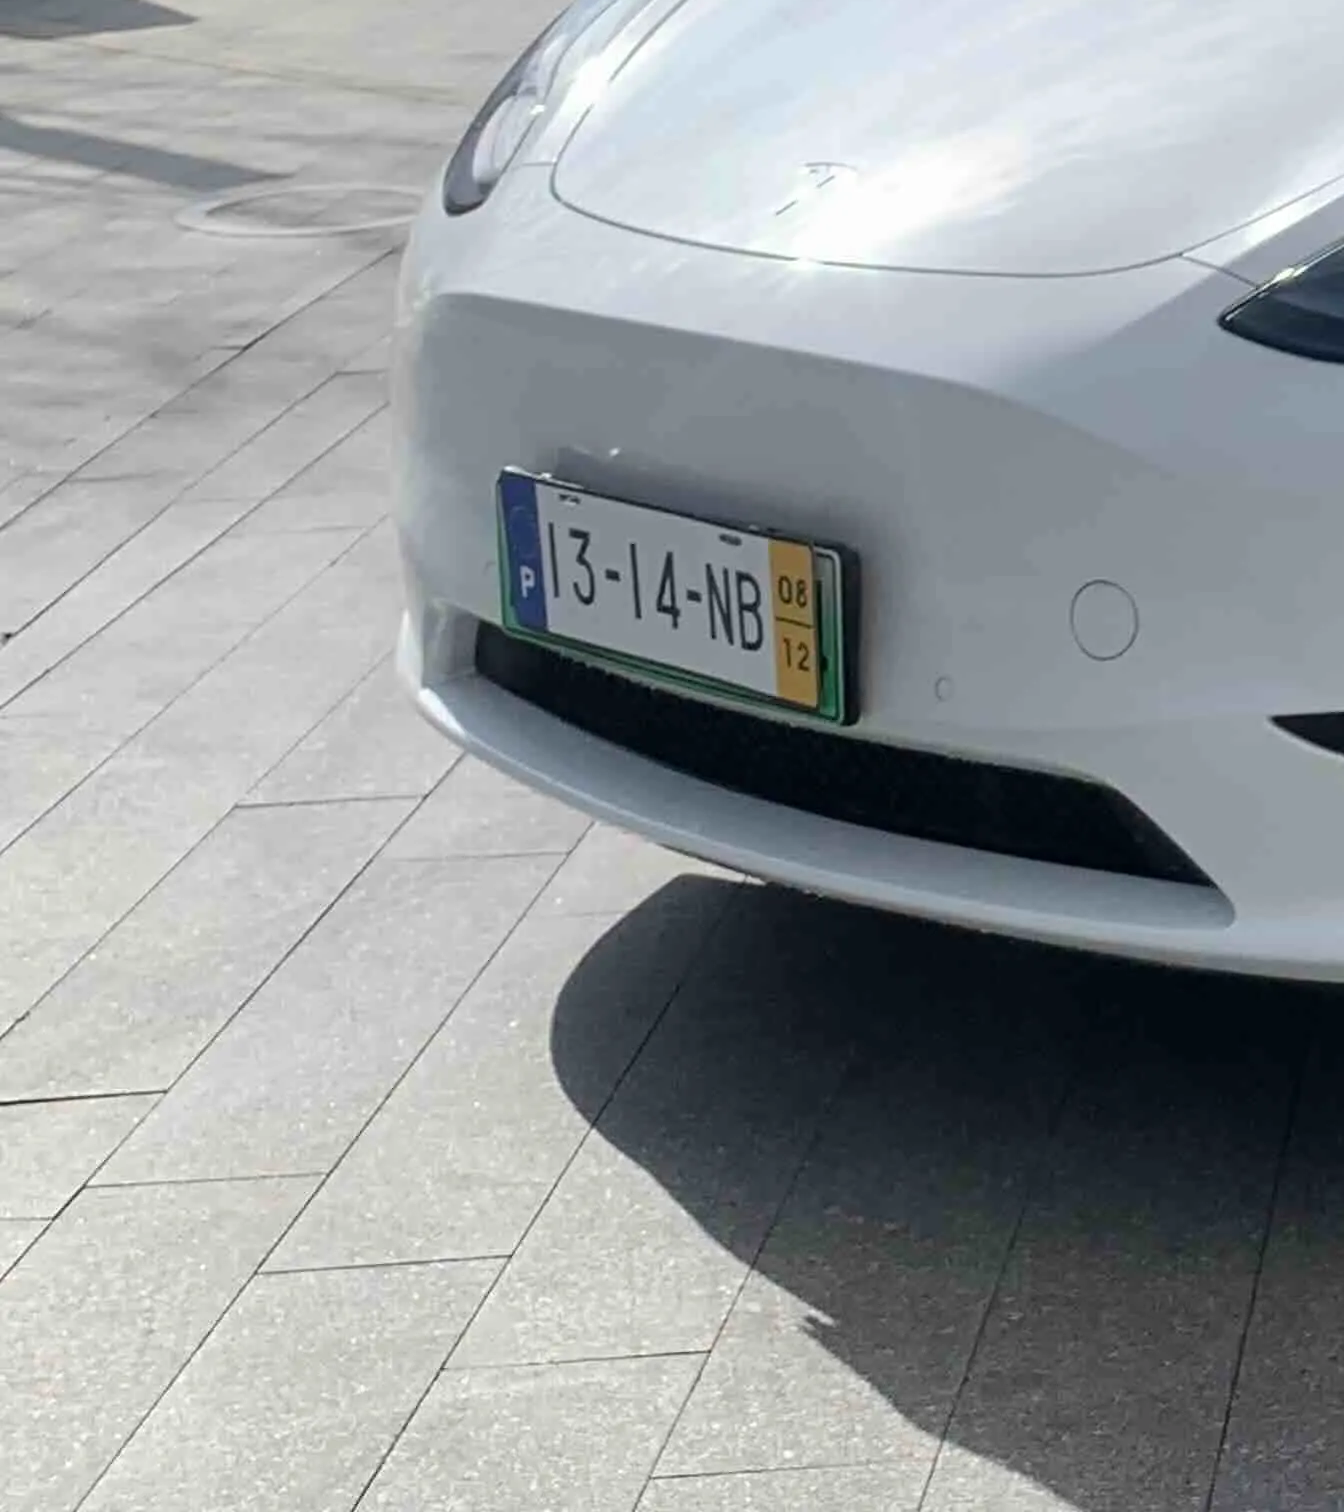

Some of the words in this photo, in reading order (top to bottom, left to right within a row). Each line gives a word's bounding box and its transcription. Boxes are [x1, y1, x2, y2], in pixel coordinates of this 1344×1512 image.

[520, 565, 536, 598] P
[547, 522, 764, 652] 13-14-NB
[777, 575, 809, 607] 08
[783, 636, 811, 673] 12
